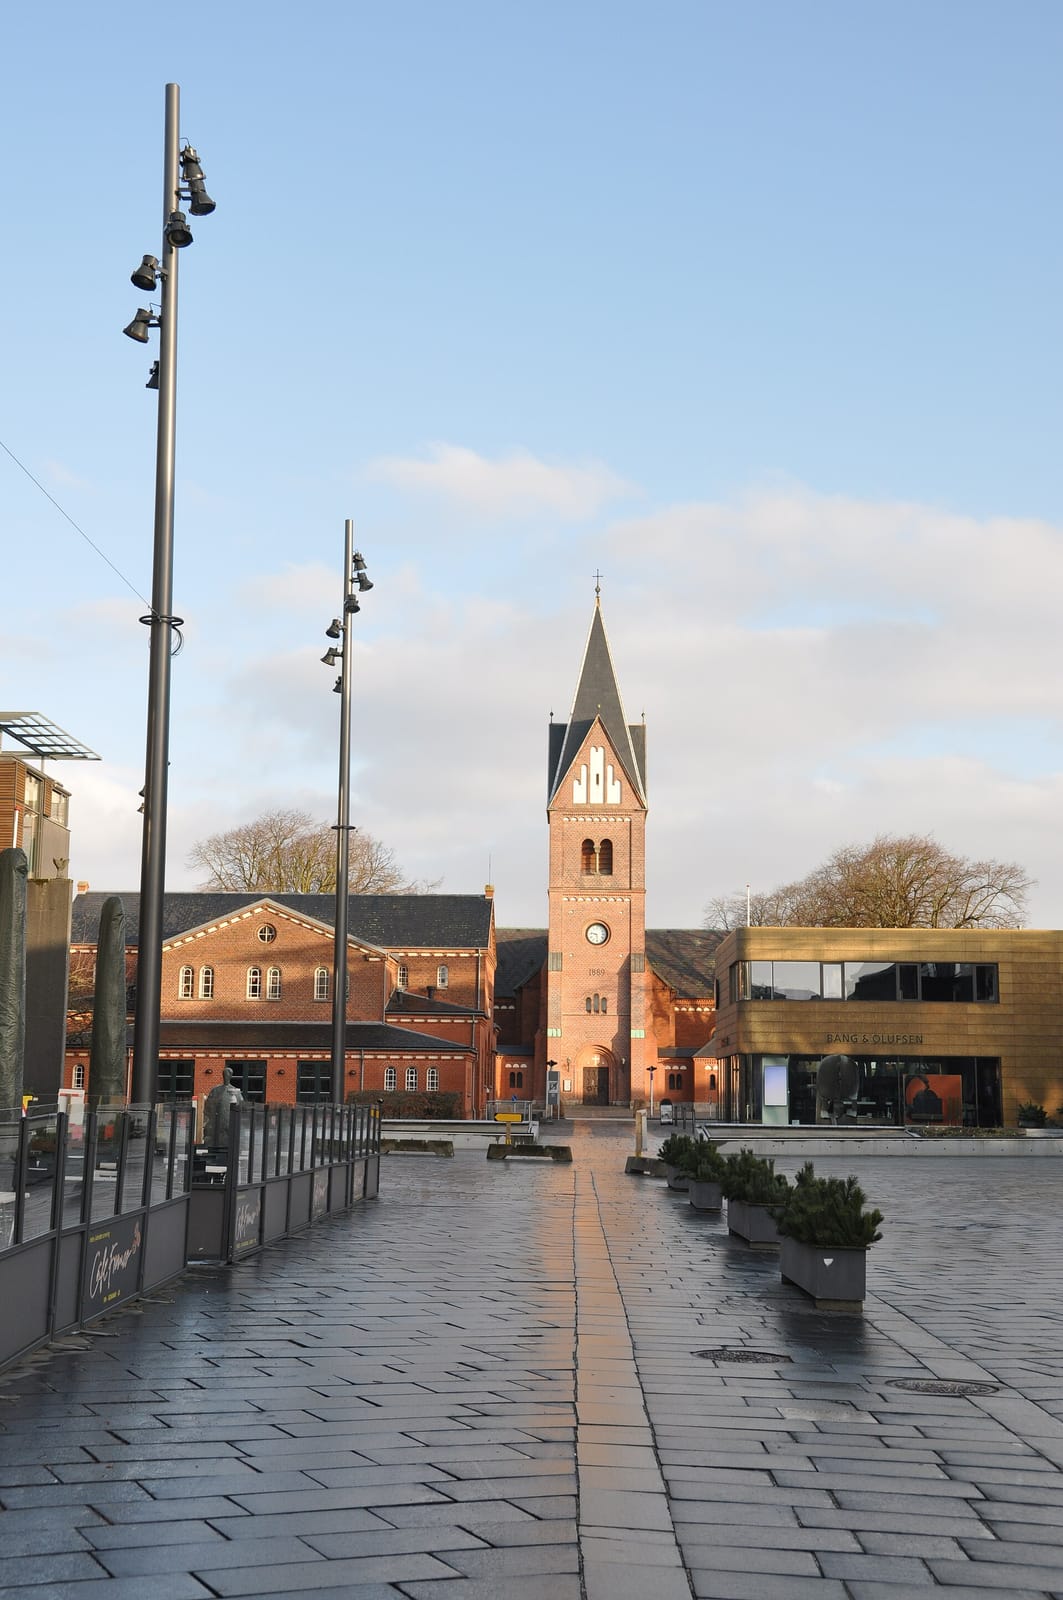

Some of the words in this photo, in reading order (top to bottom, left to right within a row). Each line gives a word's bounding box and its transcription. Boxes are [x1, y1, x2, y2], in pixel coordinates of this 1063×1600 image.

[826, 1033, 858, 1044] BANG
[862, 1034, 869, 1043] &
[872, 1034, 923, 1044] OLUFSEN
